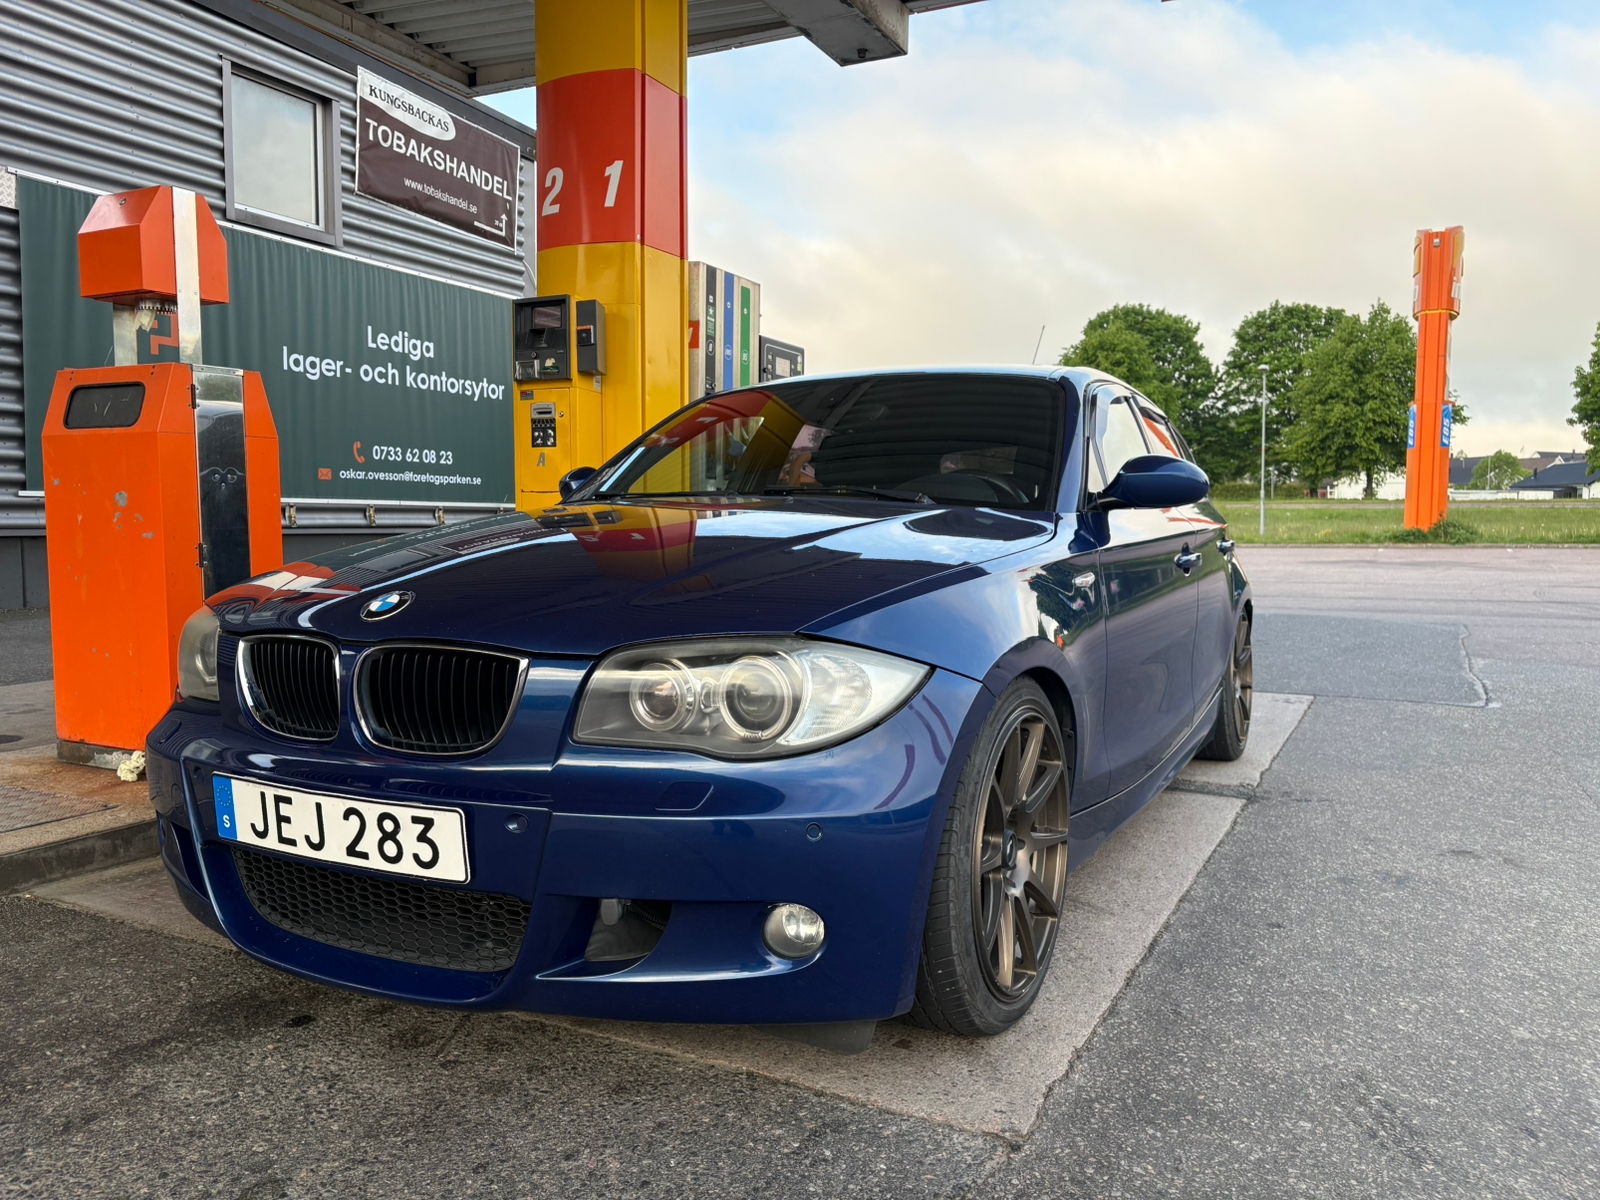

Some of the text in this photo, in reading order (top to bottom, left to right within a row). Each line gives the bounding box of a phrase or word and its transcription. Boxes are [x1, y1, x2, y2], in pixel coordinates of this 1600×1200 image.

[368, 84, 450, 132] KUNGSBACKAS
[365, 118, 512, 200] TOBAKSHANDEL
[404, 177, 478, 214] www.tobakshandel.se
[542, 167, 564, 217] 2
[604, 160, 624, 207] 1
[367, 325, 434, 361] Lediga
[283, 346, 505, 401] lager- och kontorsytor
[372, 445, 453, 465] 0733 62 08 23
[537, 452, 546, 467] A
[222, 815, 231, 828] S
[250, 791, 440, 870] JEJ 283
